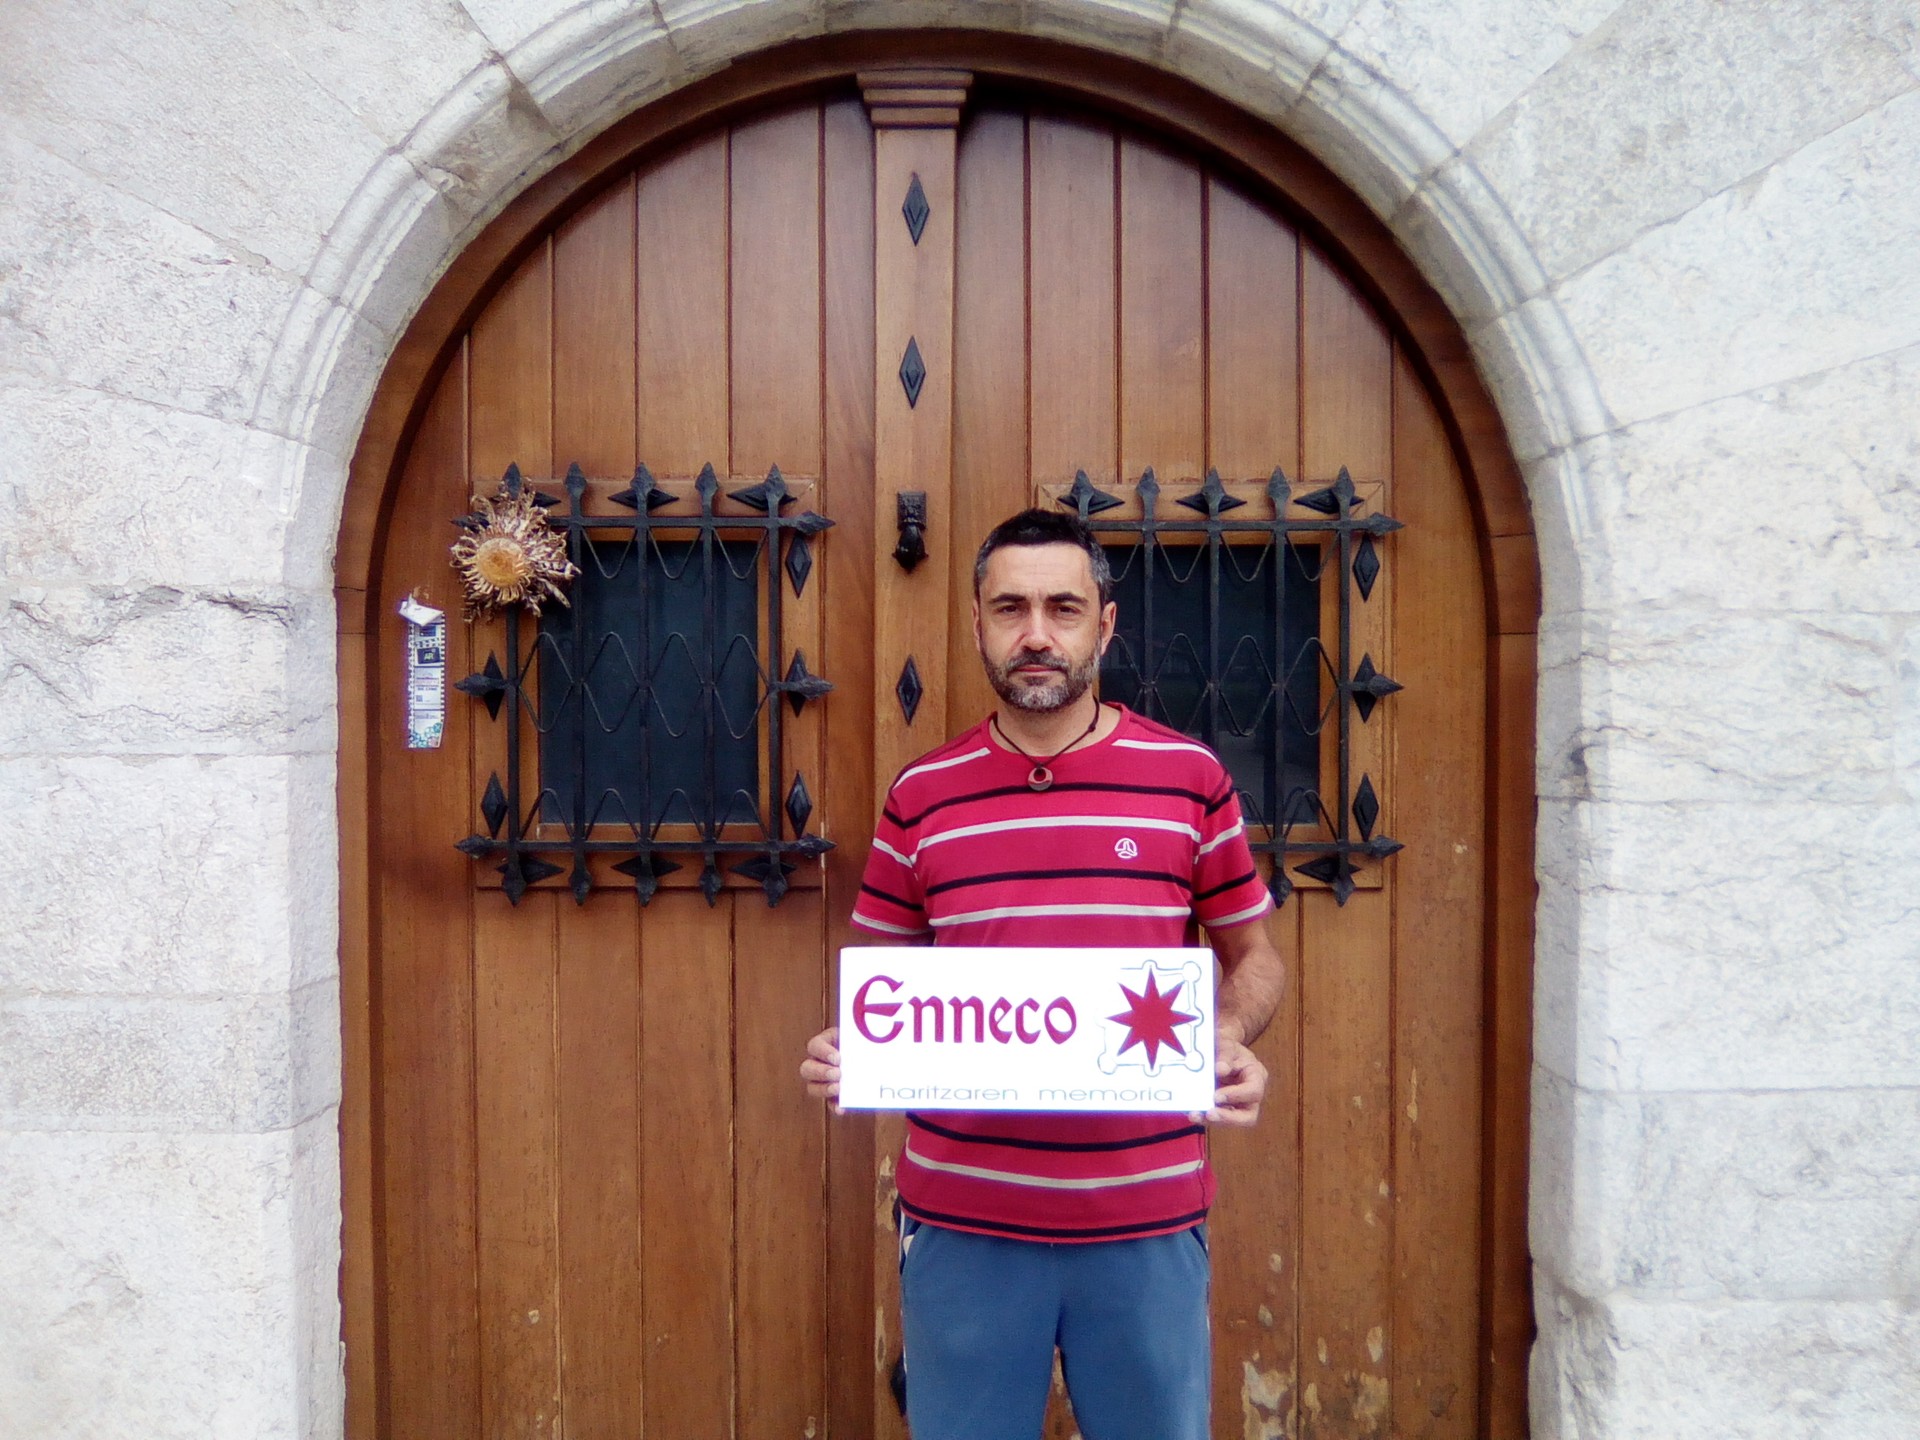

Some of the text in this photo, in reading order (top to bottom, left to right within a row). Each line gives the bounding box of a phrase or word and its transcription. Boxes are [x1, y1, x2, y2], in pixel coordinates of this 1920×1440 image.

[852, 974, 1077, 1045] Enneco
[880, 1085, 1173, 1102] haritzaren memoria
